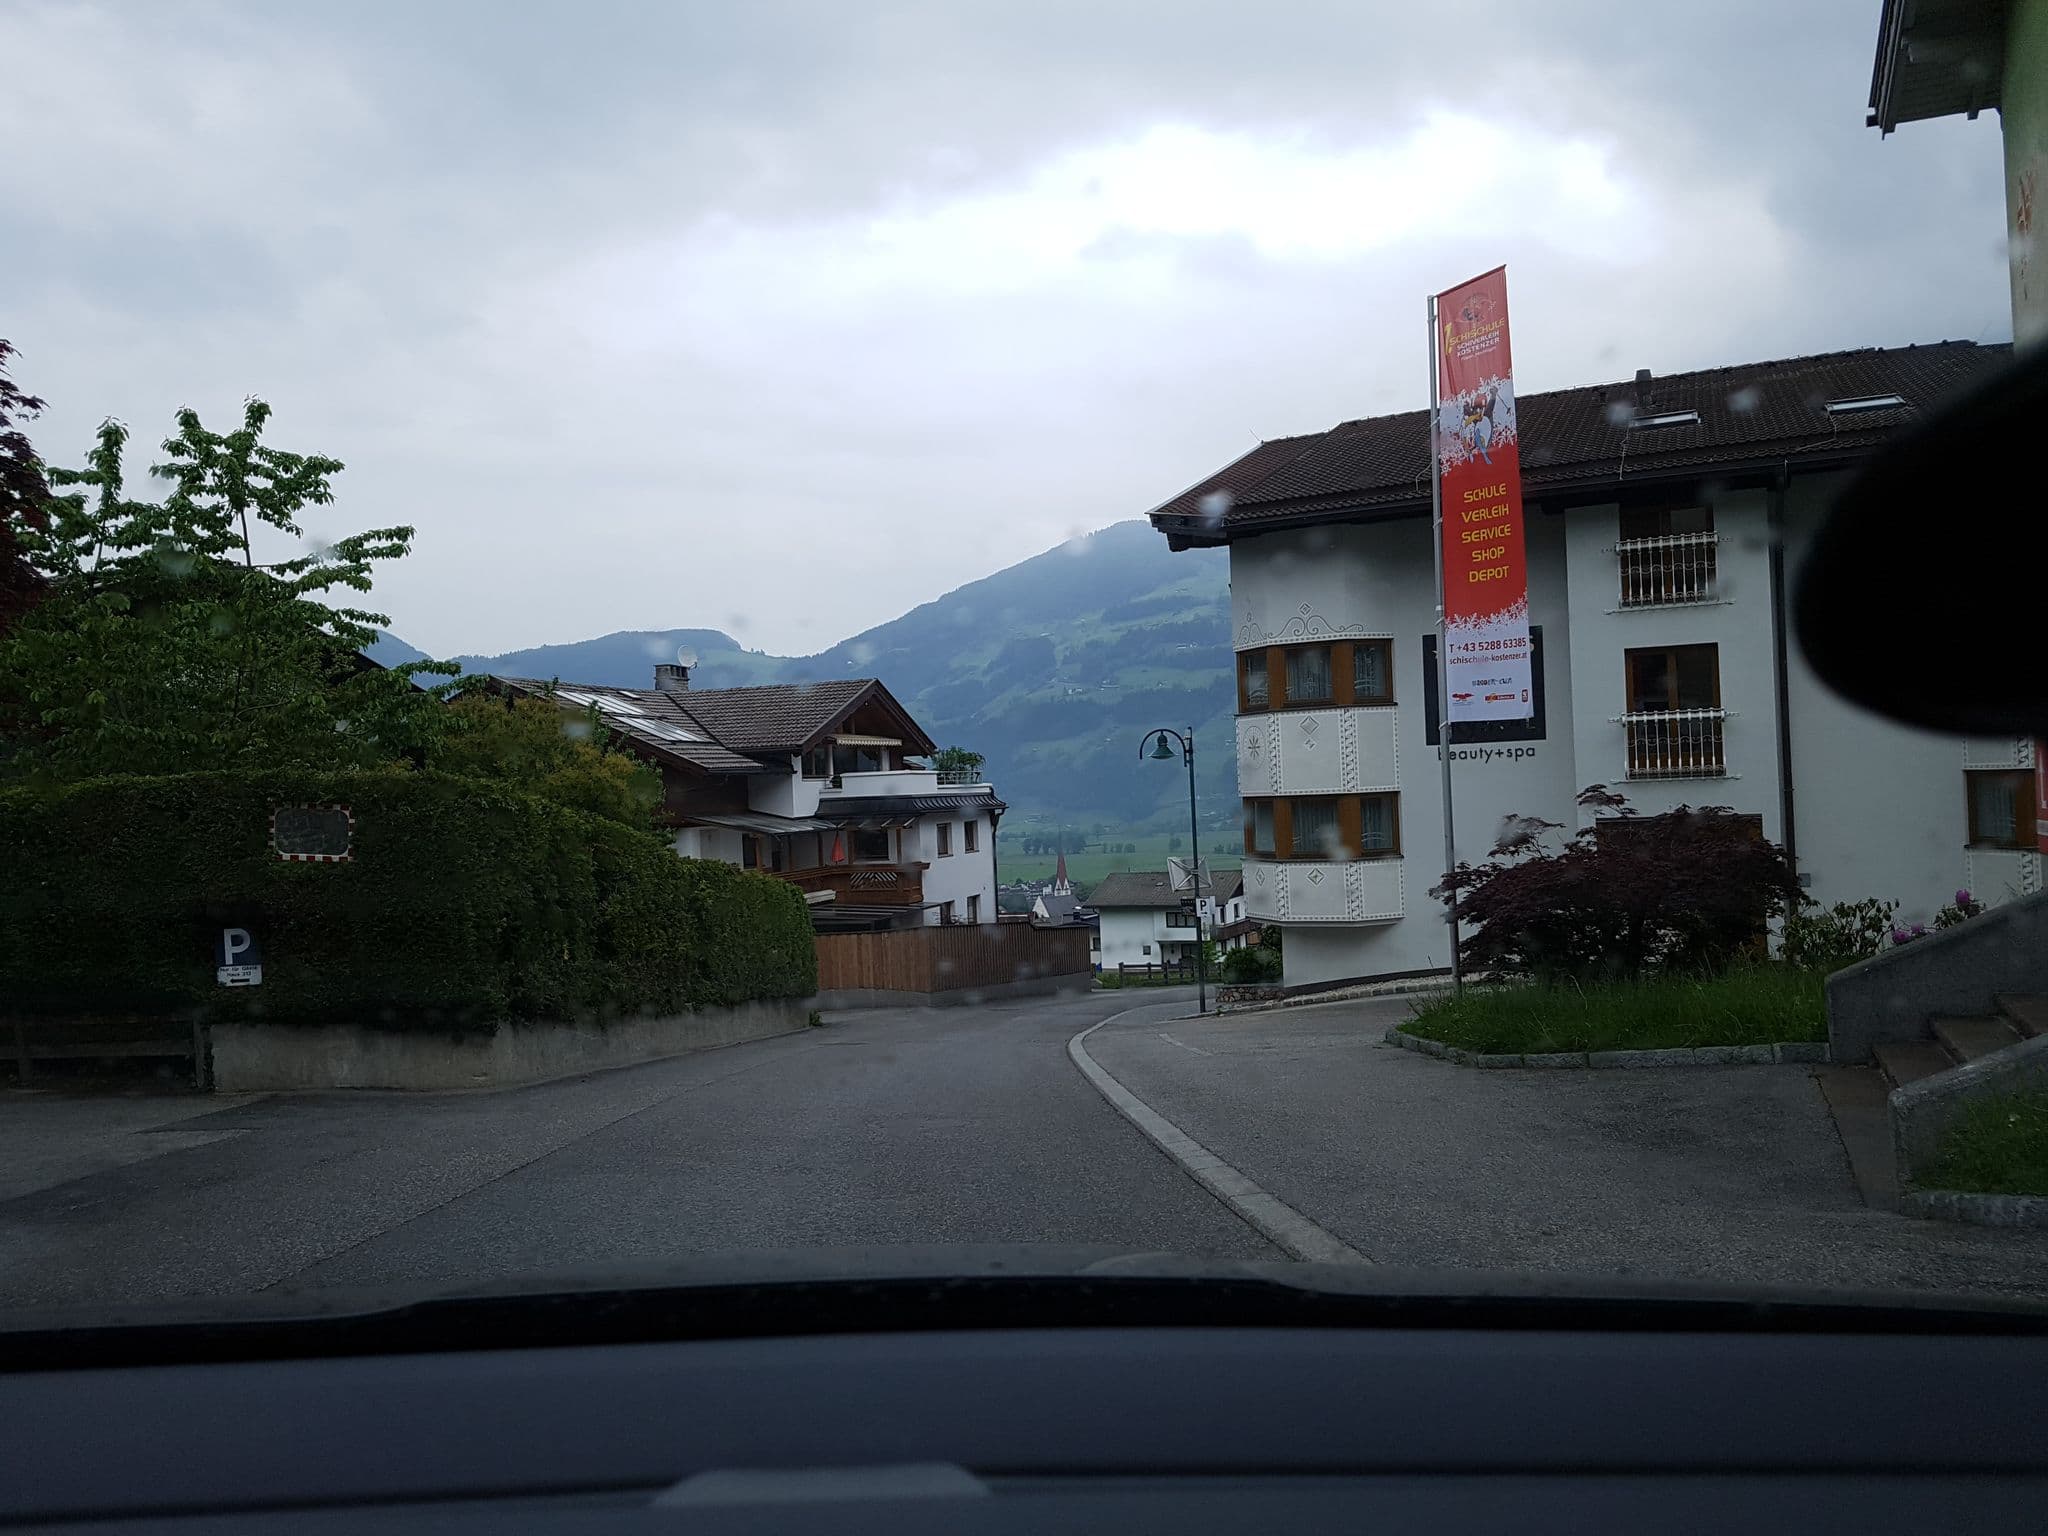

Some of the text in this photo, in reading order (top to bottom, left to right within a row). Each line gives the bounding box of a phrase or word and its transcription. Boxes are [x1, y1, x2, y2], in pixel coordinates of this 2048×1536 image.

[1463, 483, 1507, 503] SCHULE
[1461, 504, 1509, 523] VERLEIH
[1461, 524, 1511, 543] SERVICE
[1472, 546, 1505, 562] SHOP
[1469, 566, 1509, 582] DEPOT
[1449, 643, 1455, 654] T
[1457, 643, 1476, 652] +43
[1478, 639, 1502, 651] 5288
[1503, 637, 1527, 649] 63385
[1200, 900, 1207, 911] P
[224, 928, 250, 965] P
